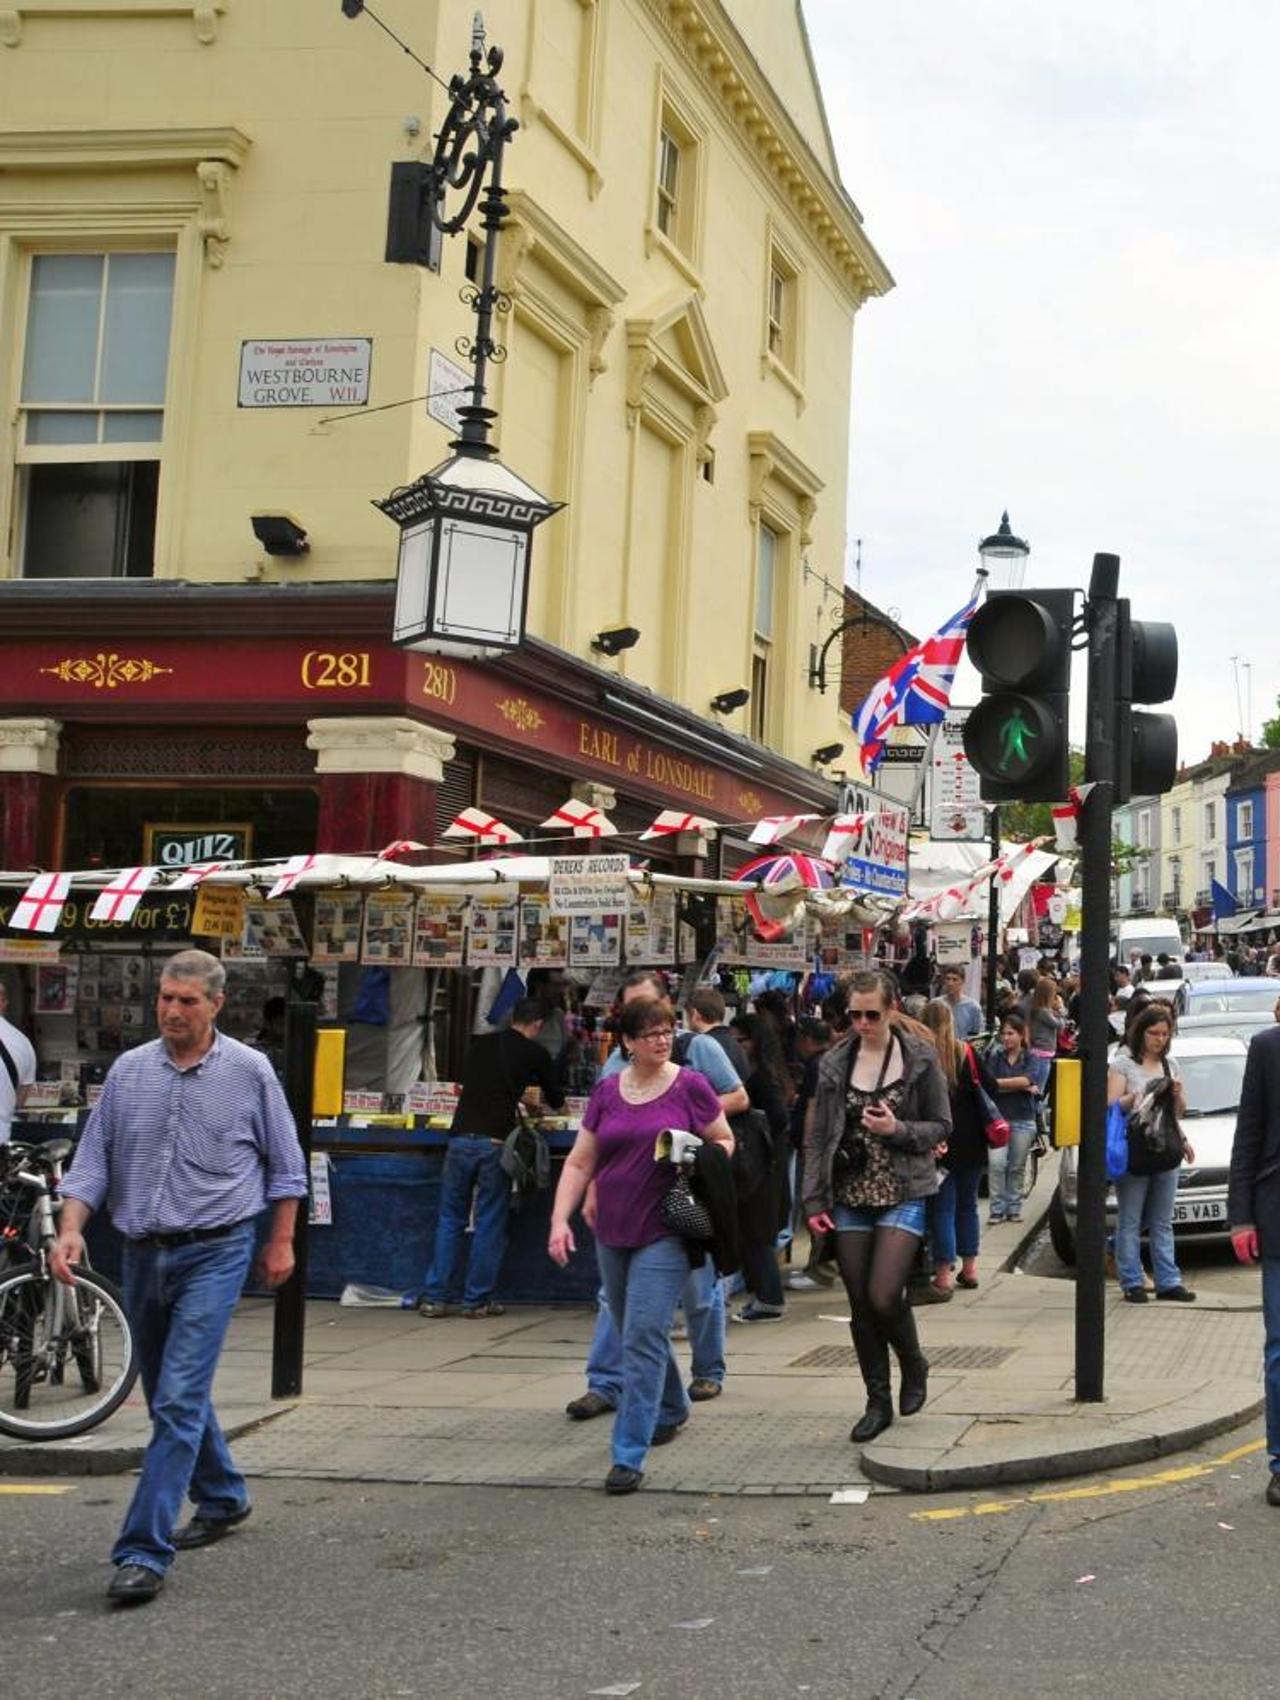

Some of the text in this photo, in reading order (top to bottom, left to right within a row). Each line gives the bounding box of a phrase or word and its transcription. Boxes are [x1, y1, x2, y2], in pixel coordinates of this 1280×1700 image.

[247, 367, 364, 385] WESTBOURNE
[301, 651, 457, 705] (281 281)
[579, 722, 716, 800] EARL of LONSDALE
[162, 833, 235, 865] QUIZ
[1192, 1203, 1221, 1219] VAB
